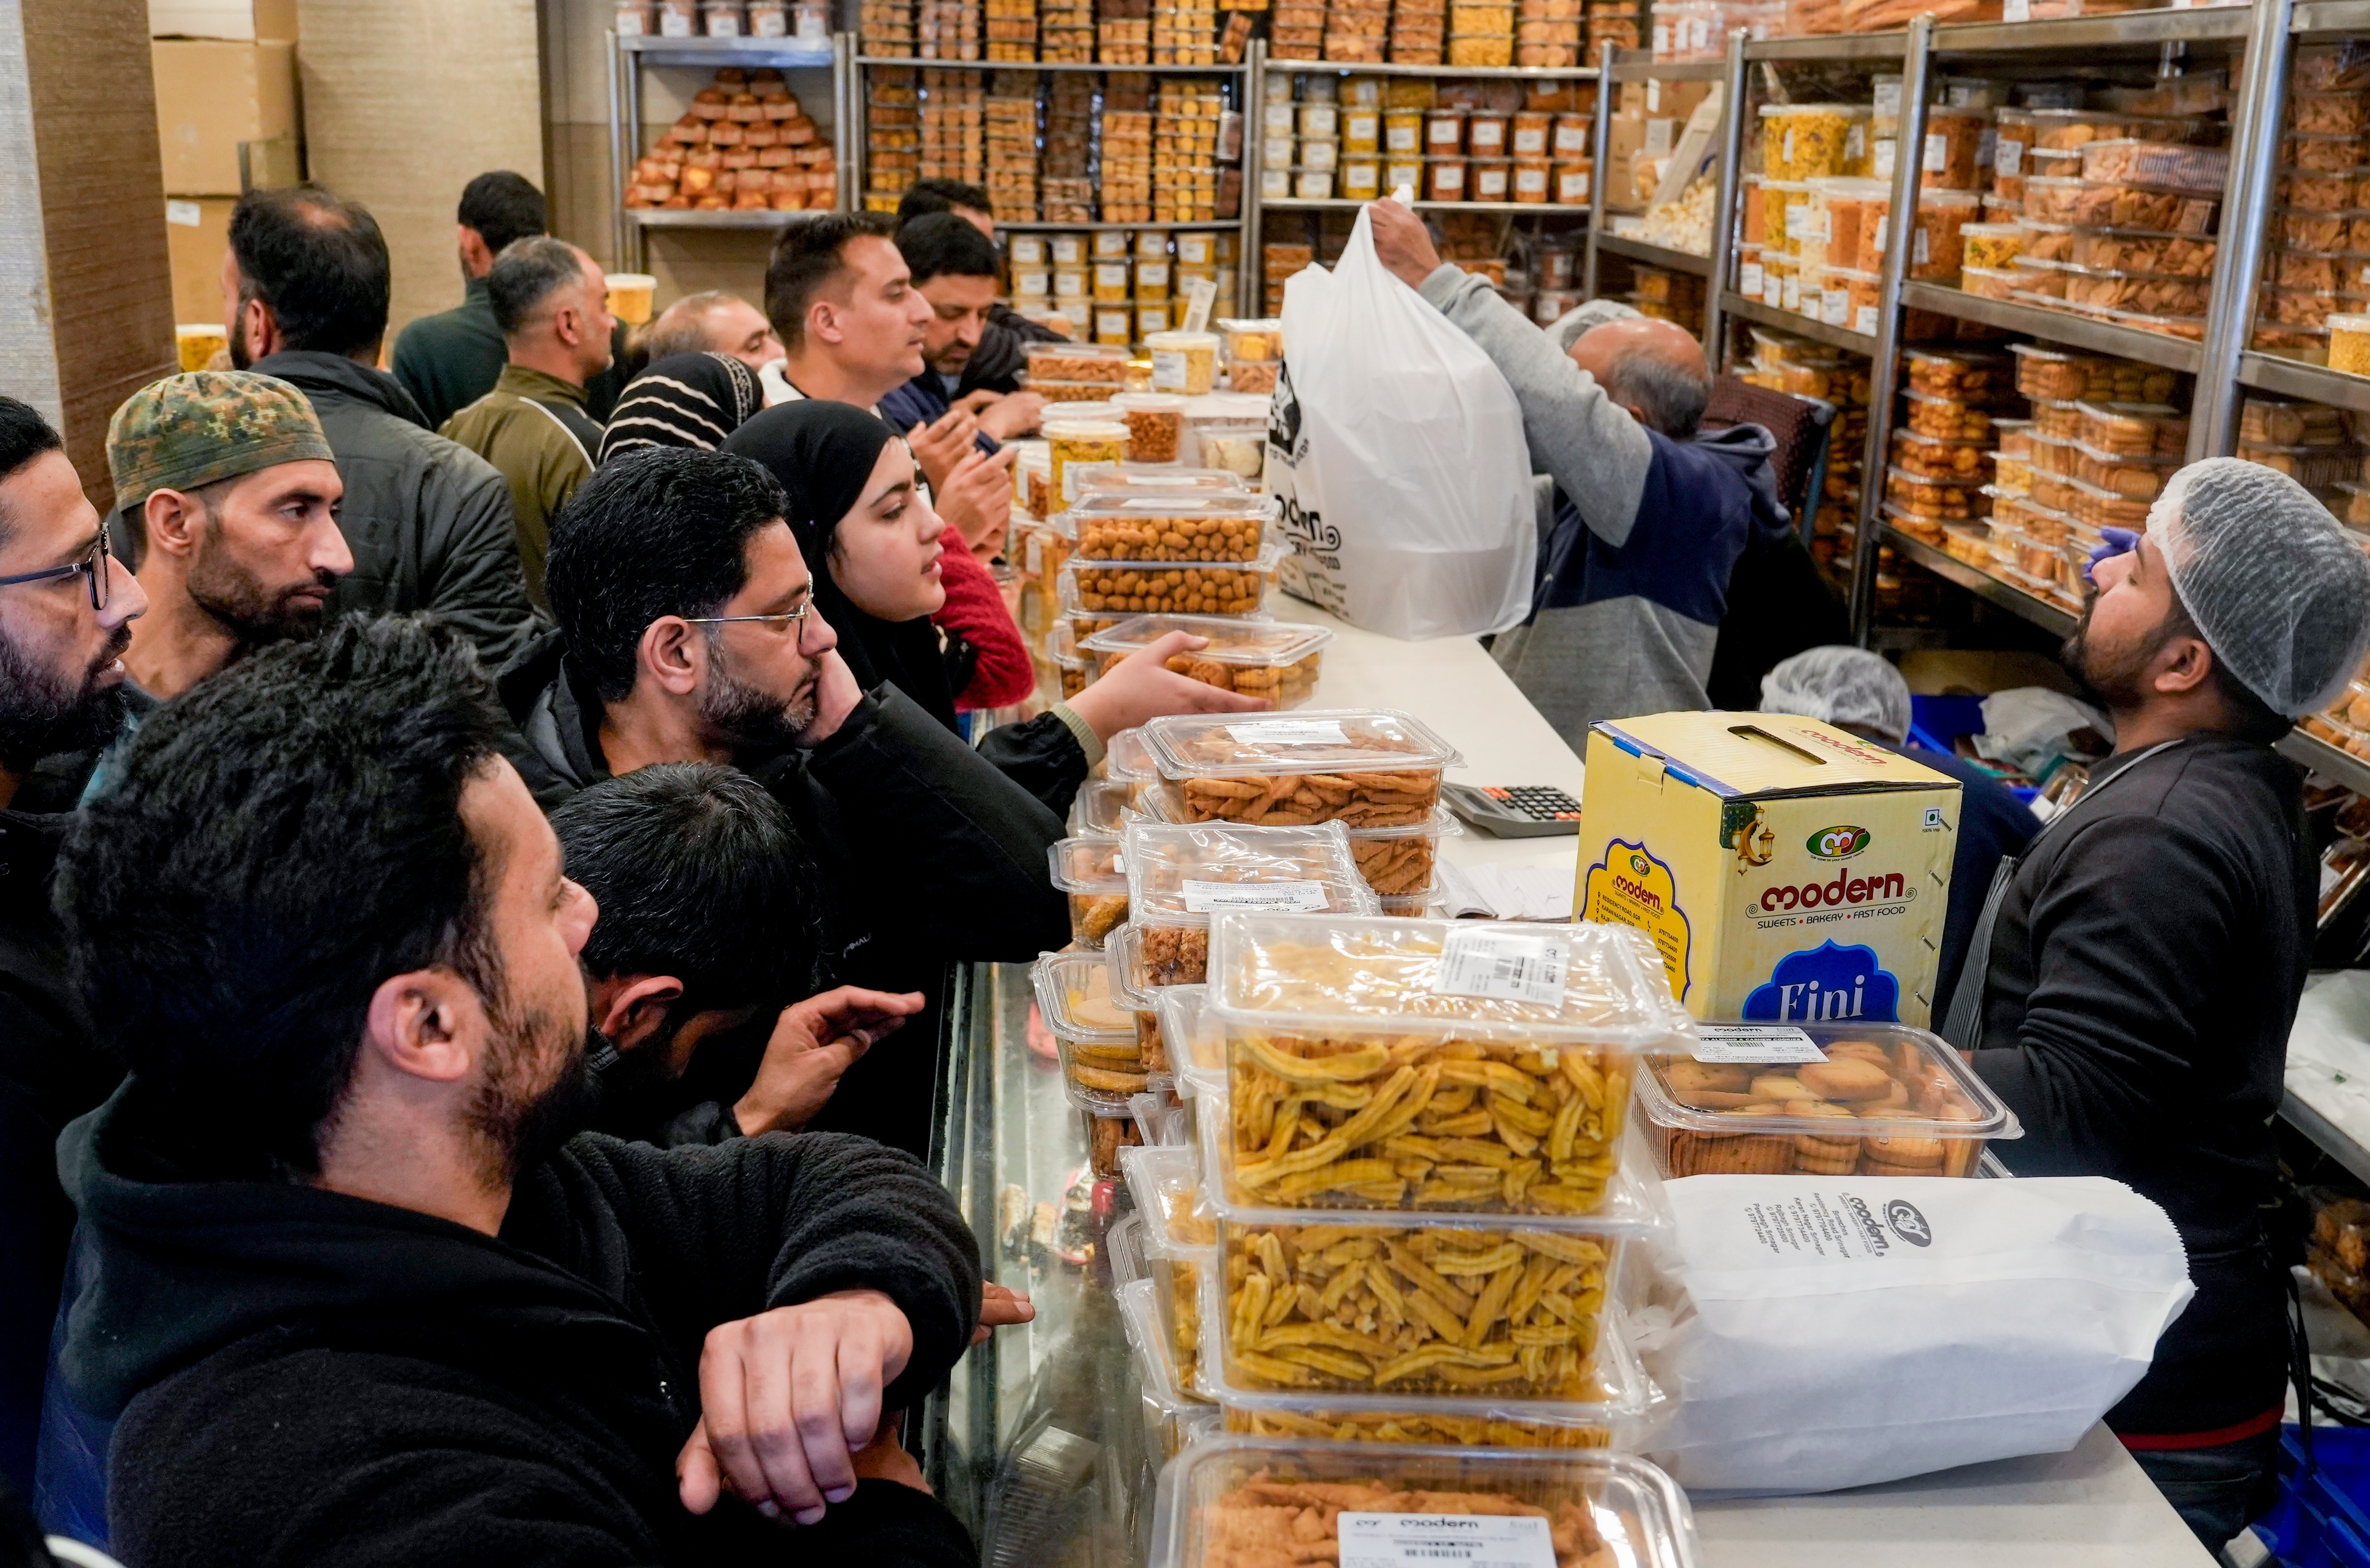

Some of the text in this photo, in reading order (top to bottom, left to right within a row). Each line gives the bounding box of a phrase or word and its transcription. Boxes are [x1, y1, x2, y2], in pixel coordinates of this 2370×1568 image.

[1802, 729, 1887, 764] modern
[1602, 895, 1622, 910] RESIDENCY
[1616, 875, 1660, 910] modern
[1761, 867, 1904, 911] modern
[1601, 904, 1614, 915] KARAN
[1650, 911, 1660, 920] FOOD
[1757, 906, 1906, 929] SWEETS BAKERY FAST FOOD
[1659, 928, 1678, 943] 9797704400
[1779, 974, 1865, 1020] Fini
[1748, 1213, 1768, 1244] 9797724400
[1752, 1203, 1780, 1254] Peerbagh Srinagar
[1769, 1212, 1789, 1243] 9797725500
[1774, 1204, 1801, 1251] Rajbagh Srinagar
[1790, 1211, 1811, 1243] 9797734400
[1793, 1197, 1826, 1256] Karan Nagar Srinagar
[1812, 1208, 1832, 1241] 9797704400
[1813, 1192, 1851, 1258] Residency Road Srinagar
[1832, 1210, 1849, 1236] Branches
[1849, 1197, 1890, 1249] modern
[1856, 1229, 1866, 1240] FAST
[1862, 1240, 1872, 1254] FOOD
[1400, 1516, 1479, 1529] modern
